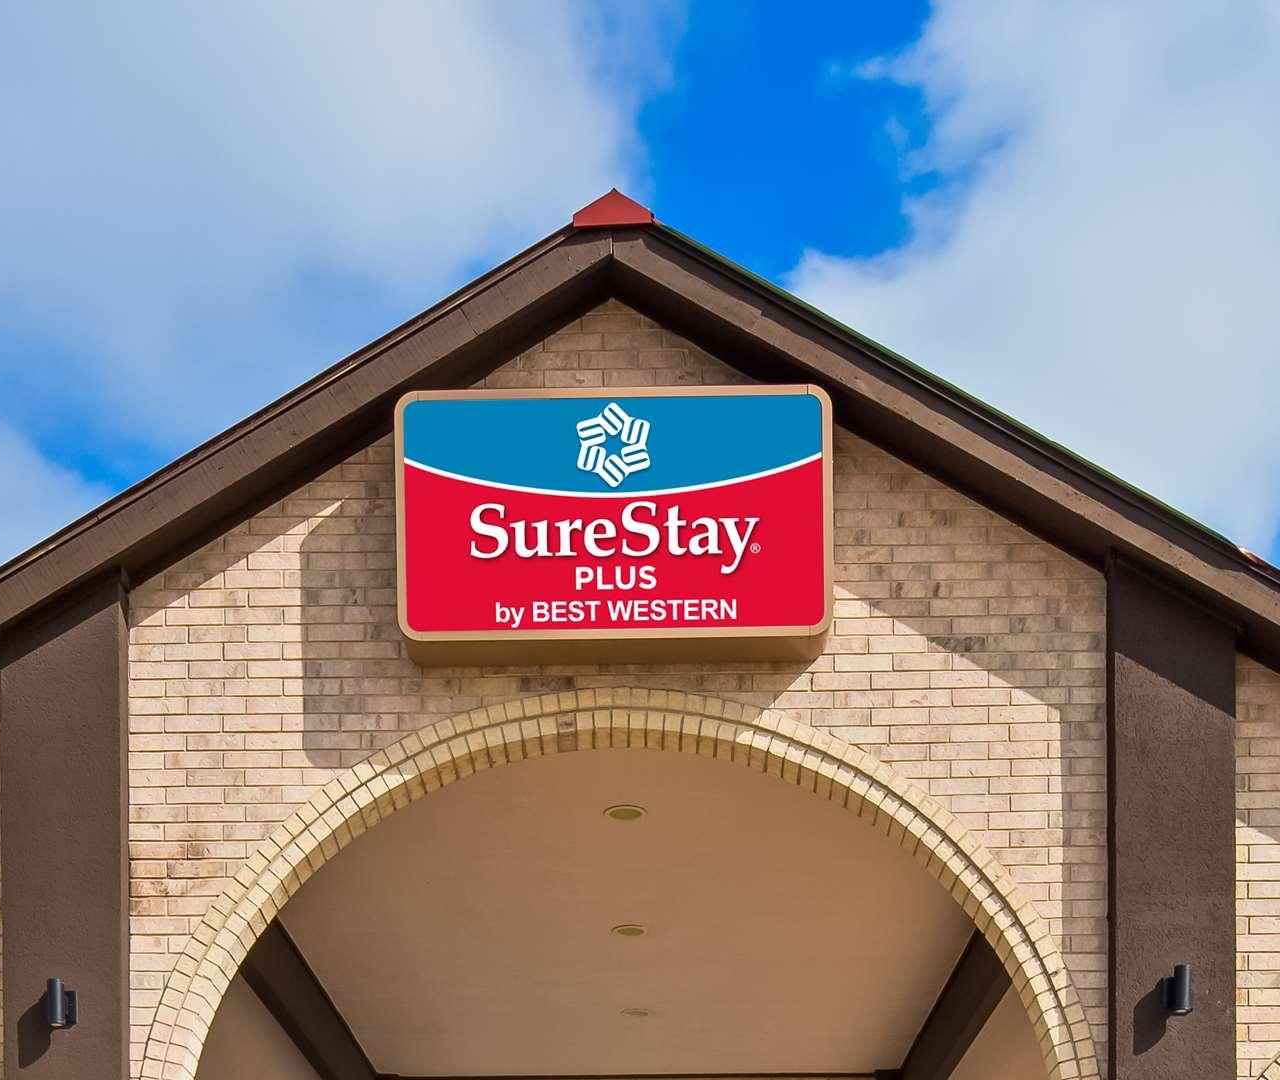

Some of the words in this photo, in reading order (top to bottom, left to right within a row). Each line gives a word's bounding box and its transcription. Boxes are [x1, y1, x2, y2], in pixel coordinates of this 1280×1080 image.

[575, 565, 657, 591] PLUS
[495, 601, 525, 629] by
[532, 600, 602, 623] BEST
[606, 598, 737, 622] WESTERN
